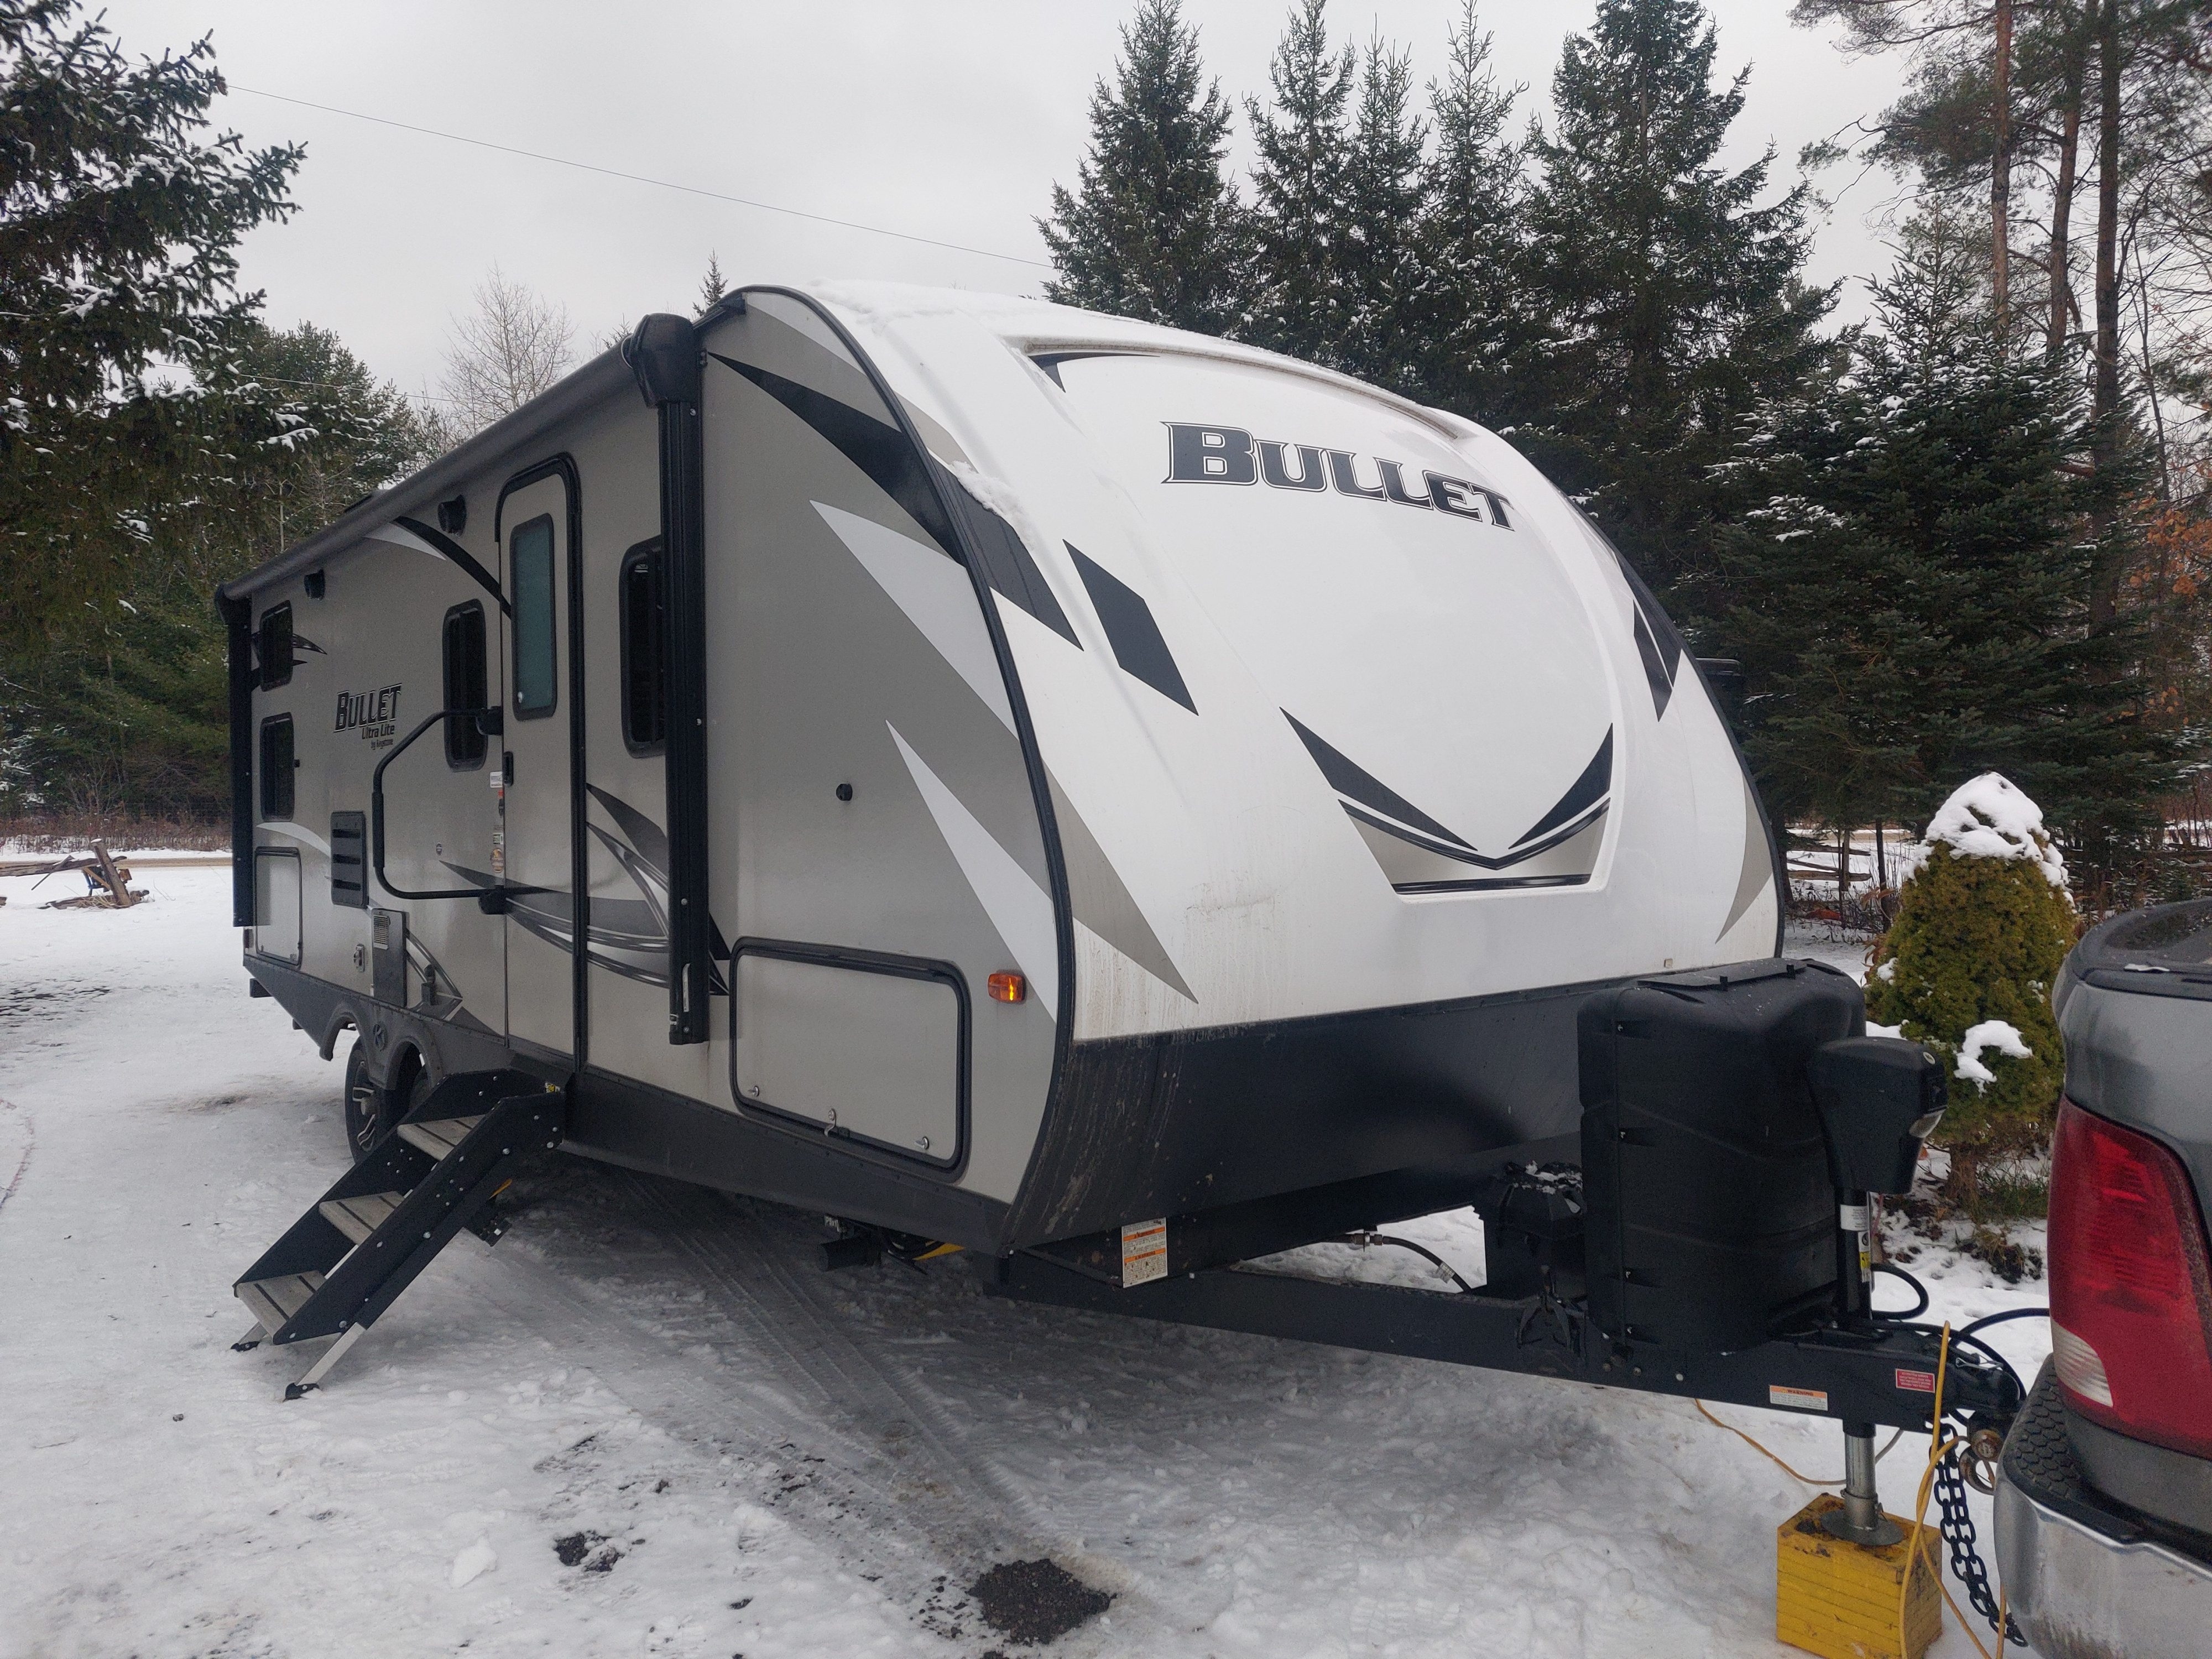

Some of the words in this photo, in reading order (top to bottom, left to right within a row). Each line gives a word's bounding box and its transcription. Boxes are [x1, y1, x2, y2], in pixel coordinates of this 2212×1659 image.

[1160, 421, 1515, 532] BULLET
[333, 682, 403, 733] BULLET
[362, 727, 379, 739] Ultra
[380, 723, 395, 737] Lite
